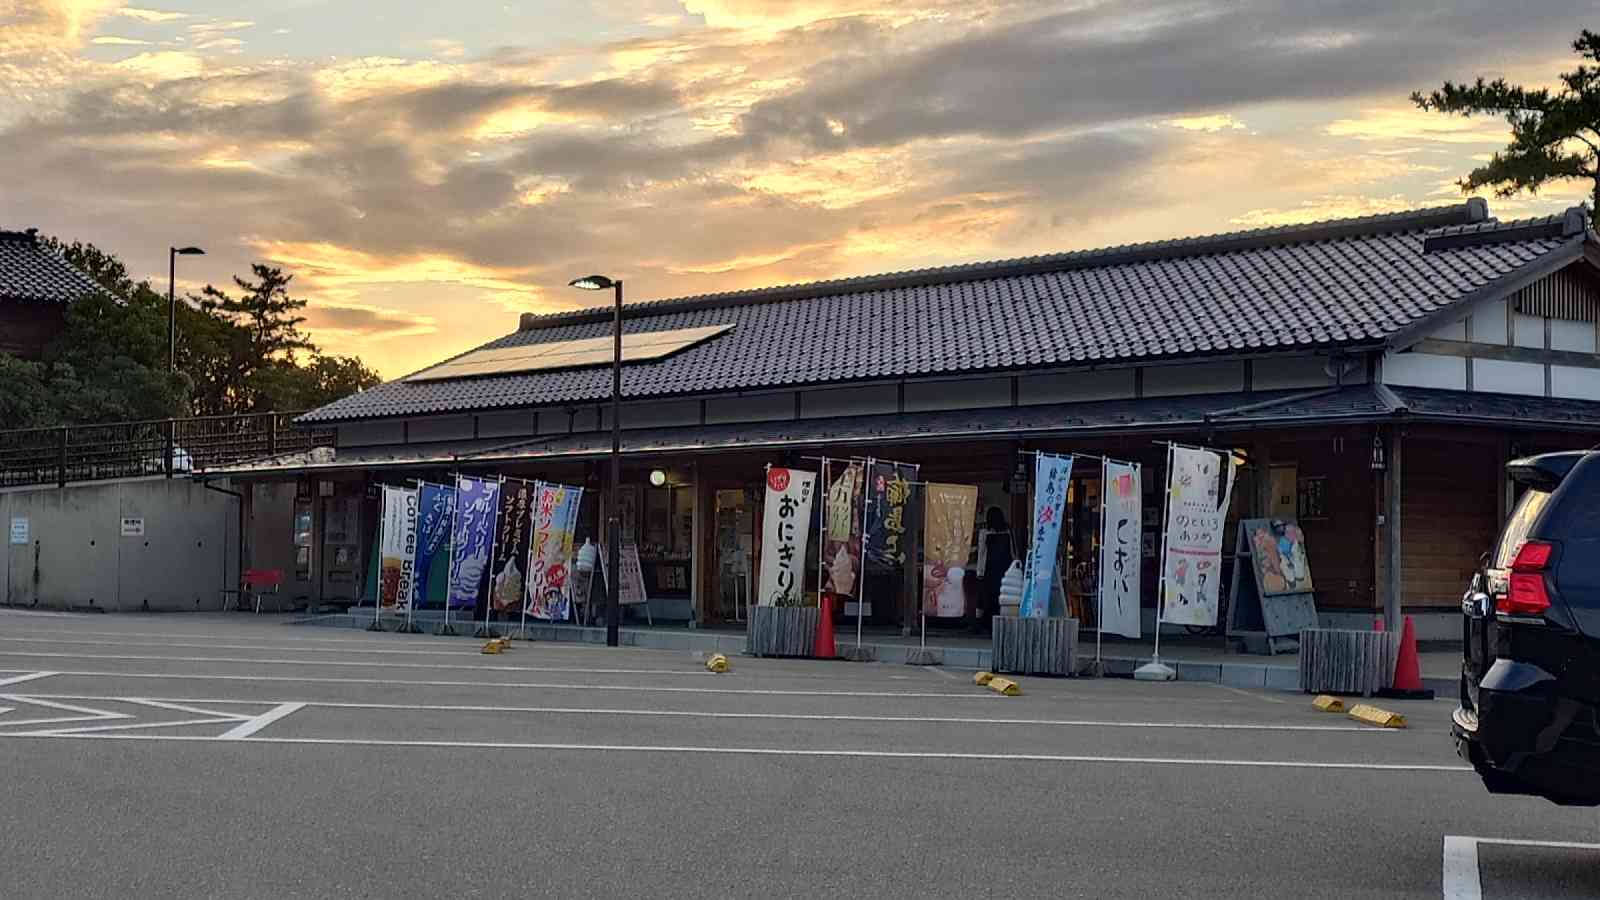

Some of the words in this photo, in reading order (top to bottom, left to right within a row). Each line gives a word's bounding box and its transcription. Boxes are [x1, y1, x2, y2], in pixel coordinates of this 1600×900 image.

[406, 495, 416, 555] Coffee
[451, 500, 475, 587] ソフトクリーム
[499, 496, 514, 561] ソフトクリーム
[530, 489, 553, 616] お米ソフトクリーム
[777, 494, 799, 597] おにぎり
[397, 559, 413, 610] Break
